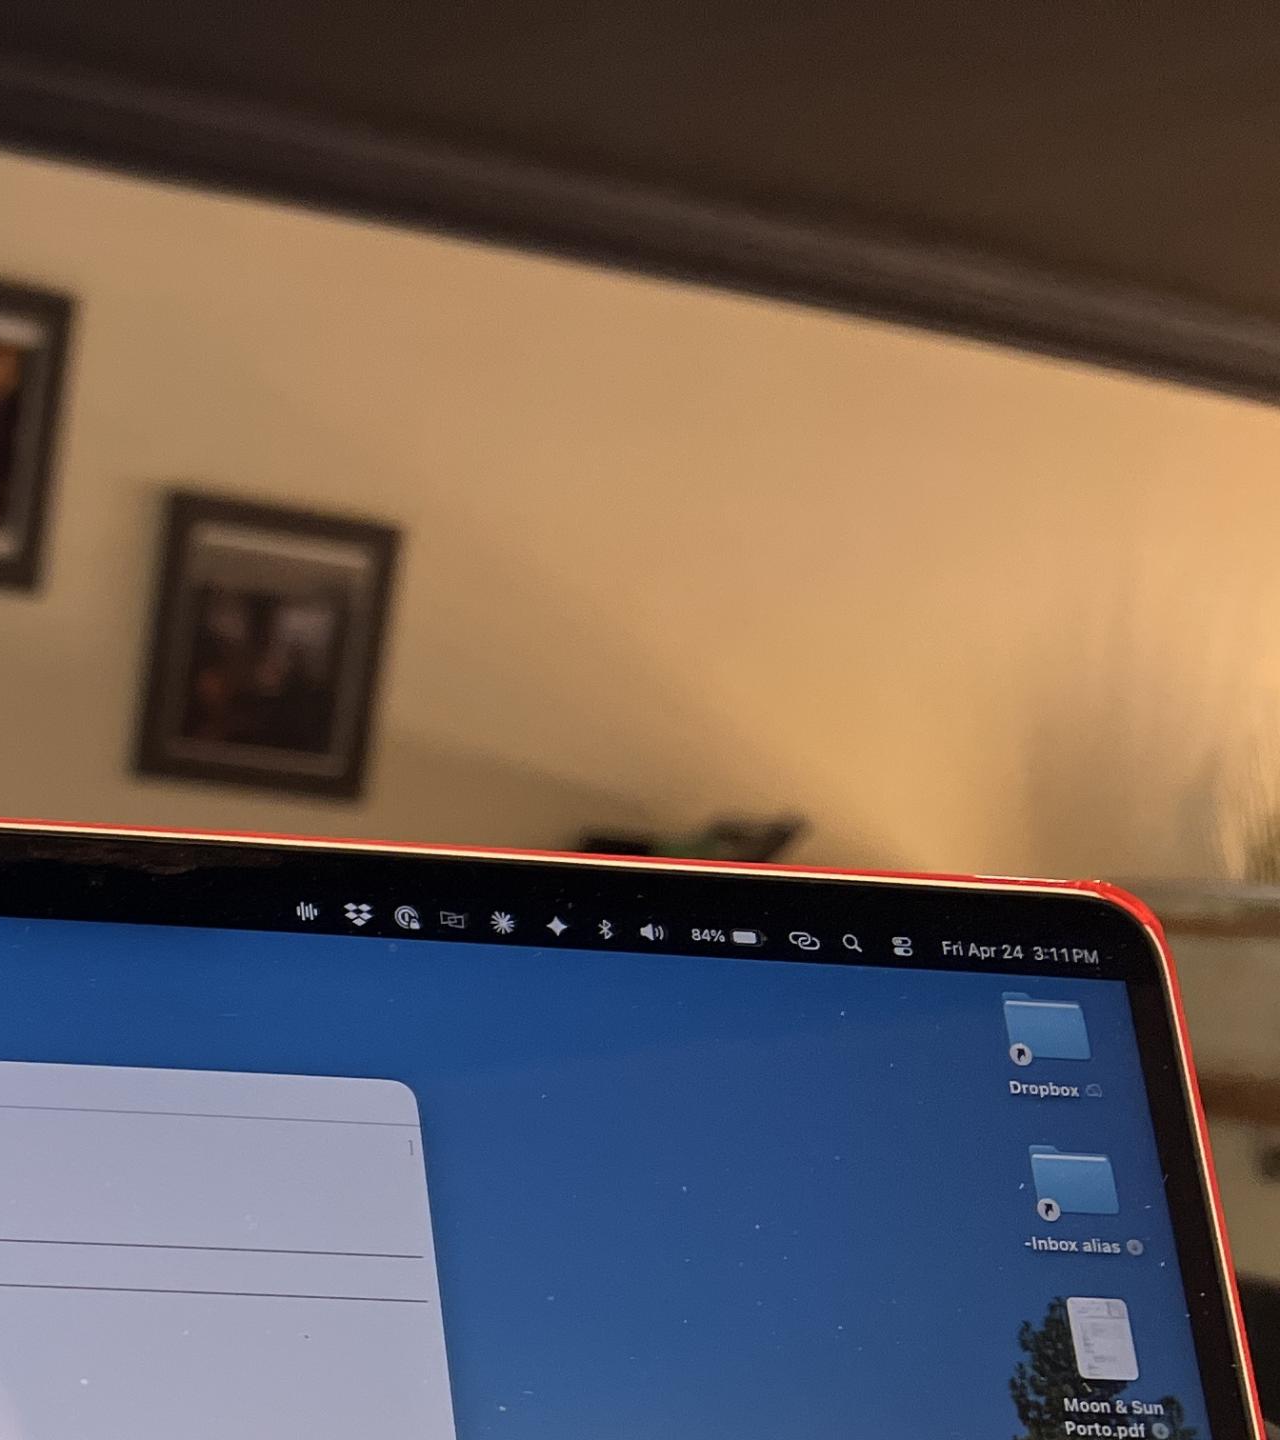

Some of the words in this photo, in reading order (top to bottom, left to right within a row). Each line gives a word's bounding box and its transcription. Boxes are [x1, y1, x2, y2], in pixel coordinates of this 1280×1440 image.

[691, 928, 726, 943] 84%
[941, 940, 964, 956] Fri
[968, 942, 997, 960] Apr
[1001, 944, 1025, 960] 24
[1008, 1080, 1080, 1098] Dropbox
[1082, 1238, 1122, 1254] alias
[1063, 1397, 1111, 1415] Moon
[1115, 1399, 1128, 1415] &
[1131, 1399, 1165, 1416] Sun
[1064, 1420, 1146, 1440] Porto.pdf
